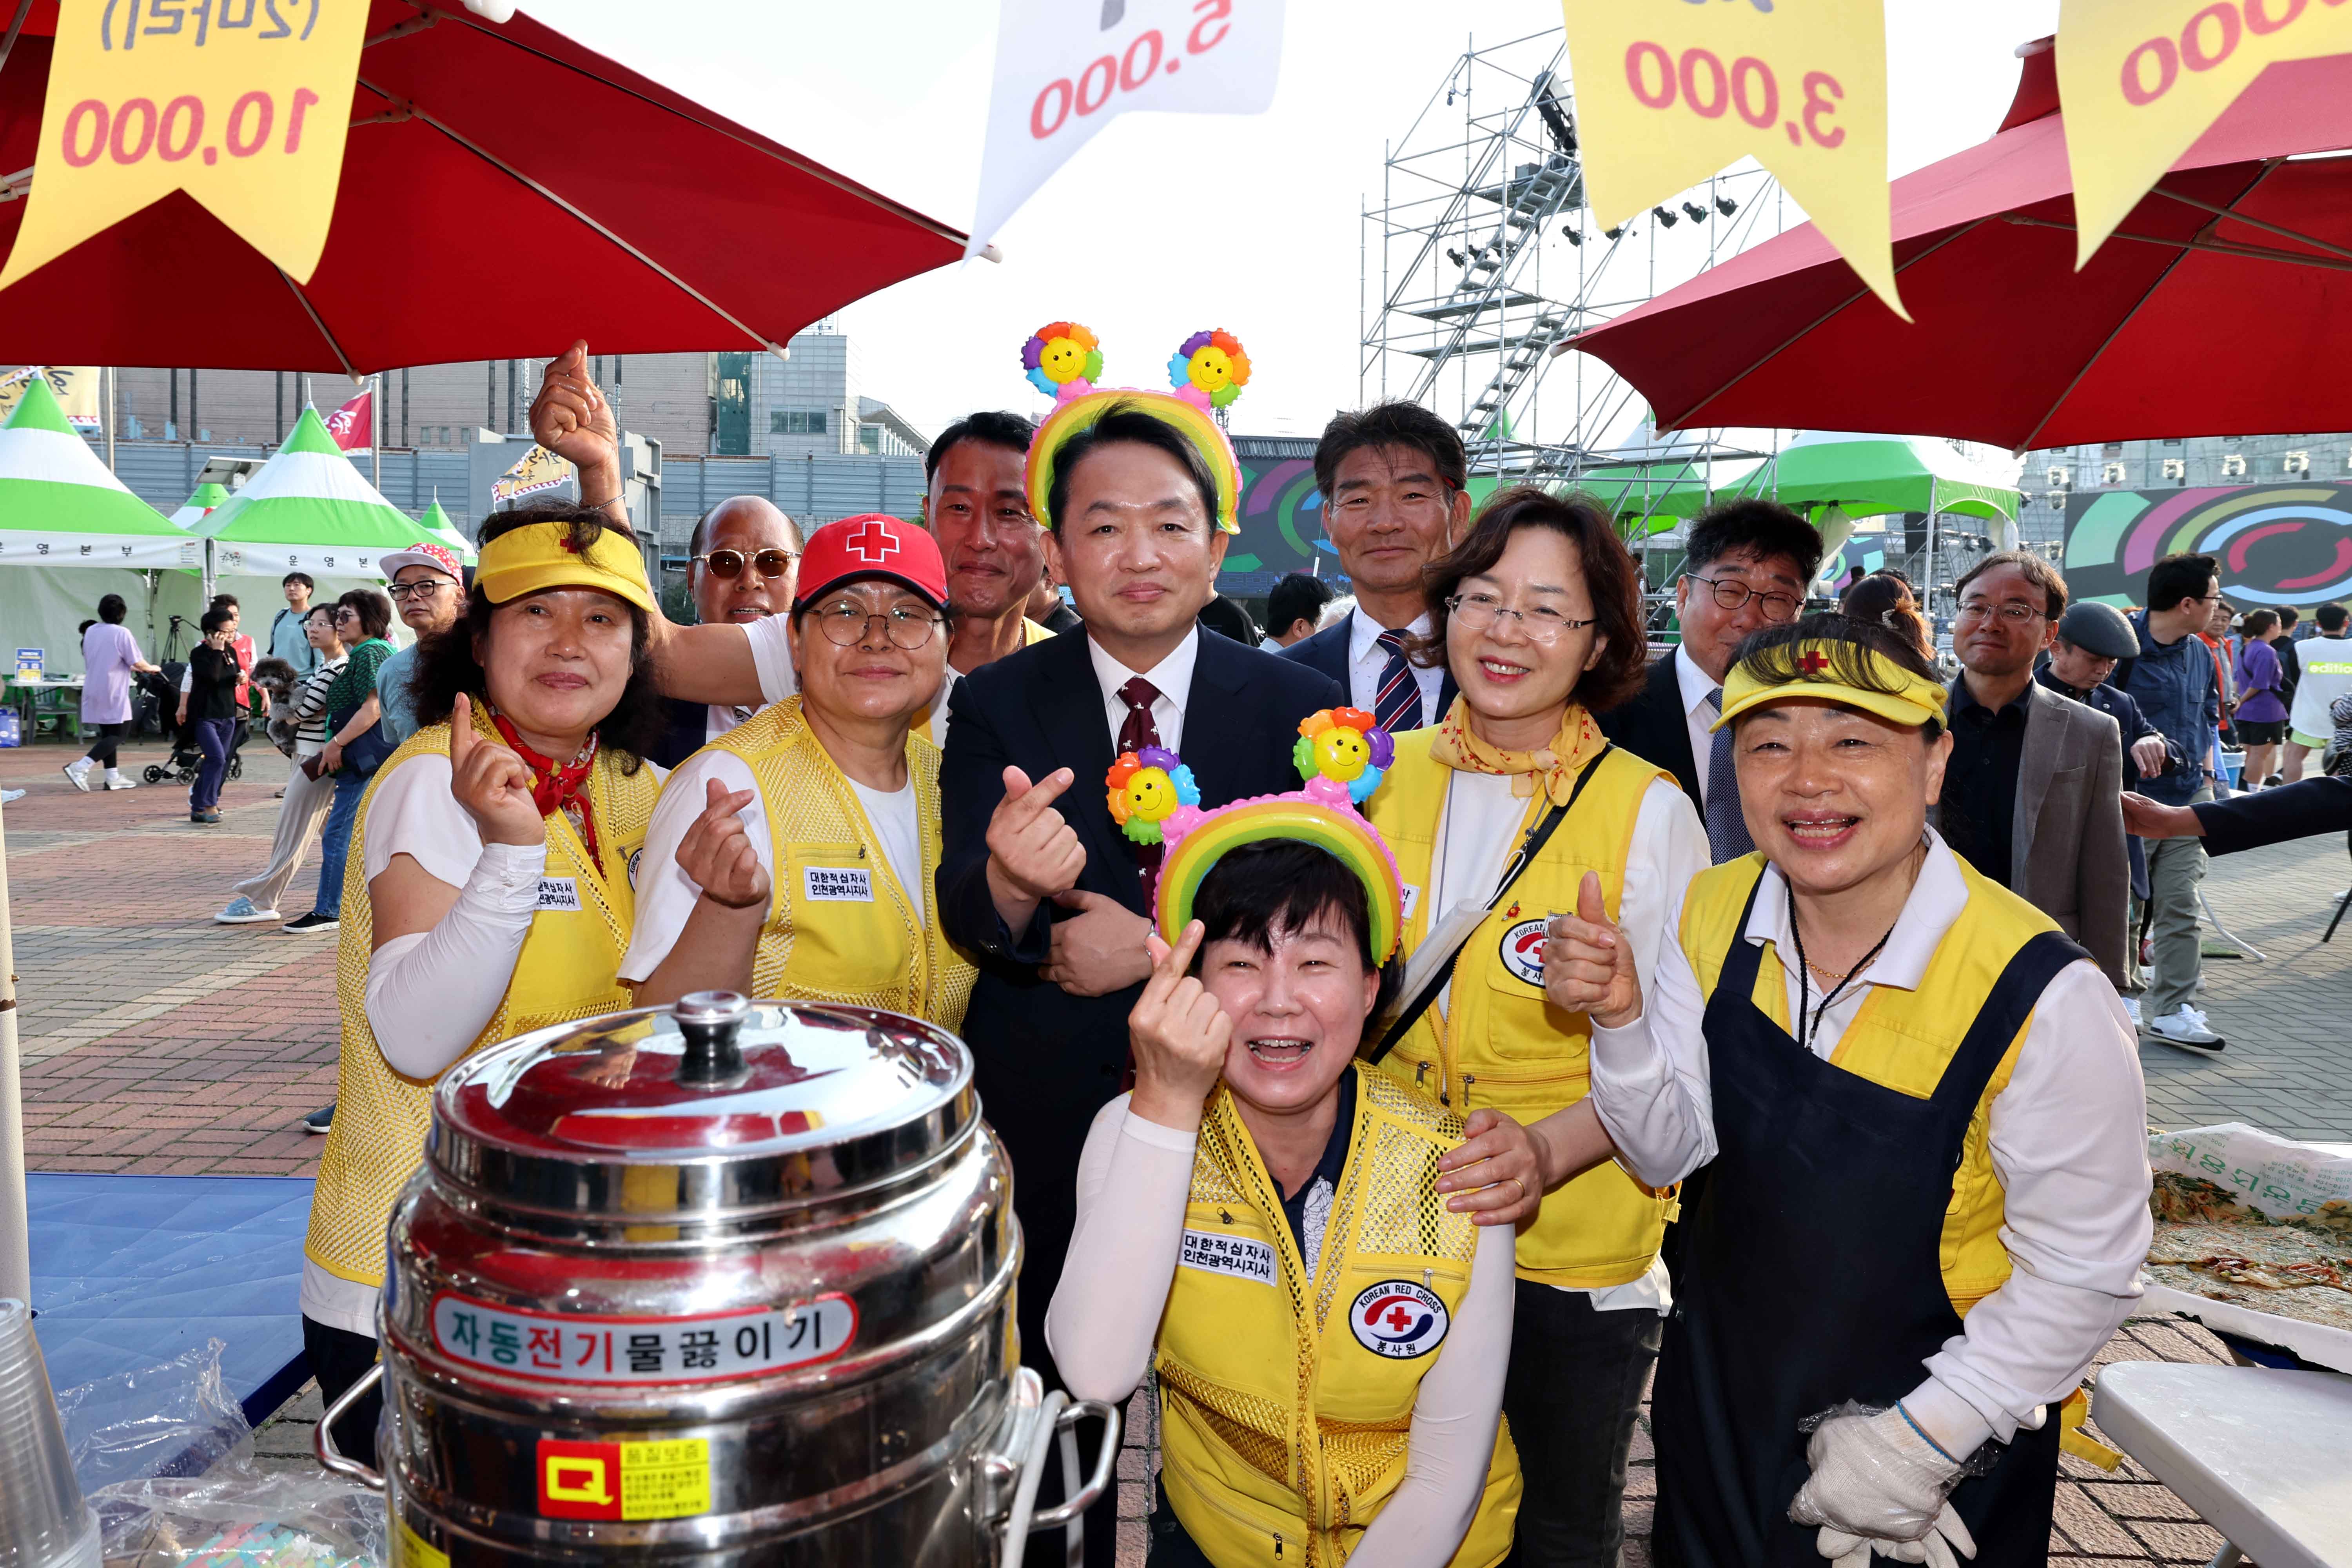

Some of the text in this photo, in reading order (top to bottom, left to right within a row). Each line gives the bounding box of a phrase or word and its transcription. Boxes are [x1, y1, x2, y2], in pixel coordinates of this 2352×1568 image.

[810, 872, 866, 885] 대한적십자사
[811, 884, 868, 897] 인천광역시지사
[537, 894, 575, 906] 천광역시지사
[1521, 967, 1543, 982] 봉사
[1185, 1235, 1270, 1263] 대한적십자사
[1184, 1249, 1270, 1278] 인천광역시지사
[1358, 1285, 1442, 1314] KOREAN RED CROSS
[1377, 1340, 1418, 1356] 봉사원
